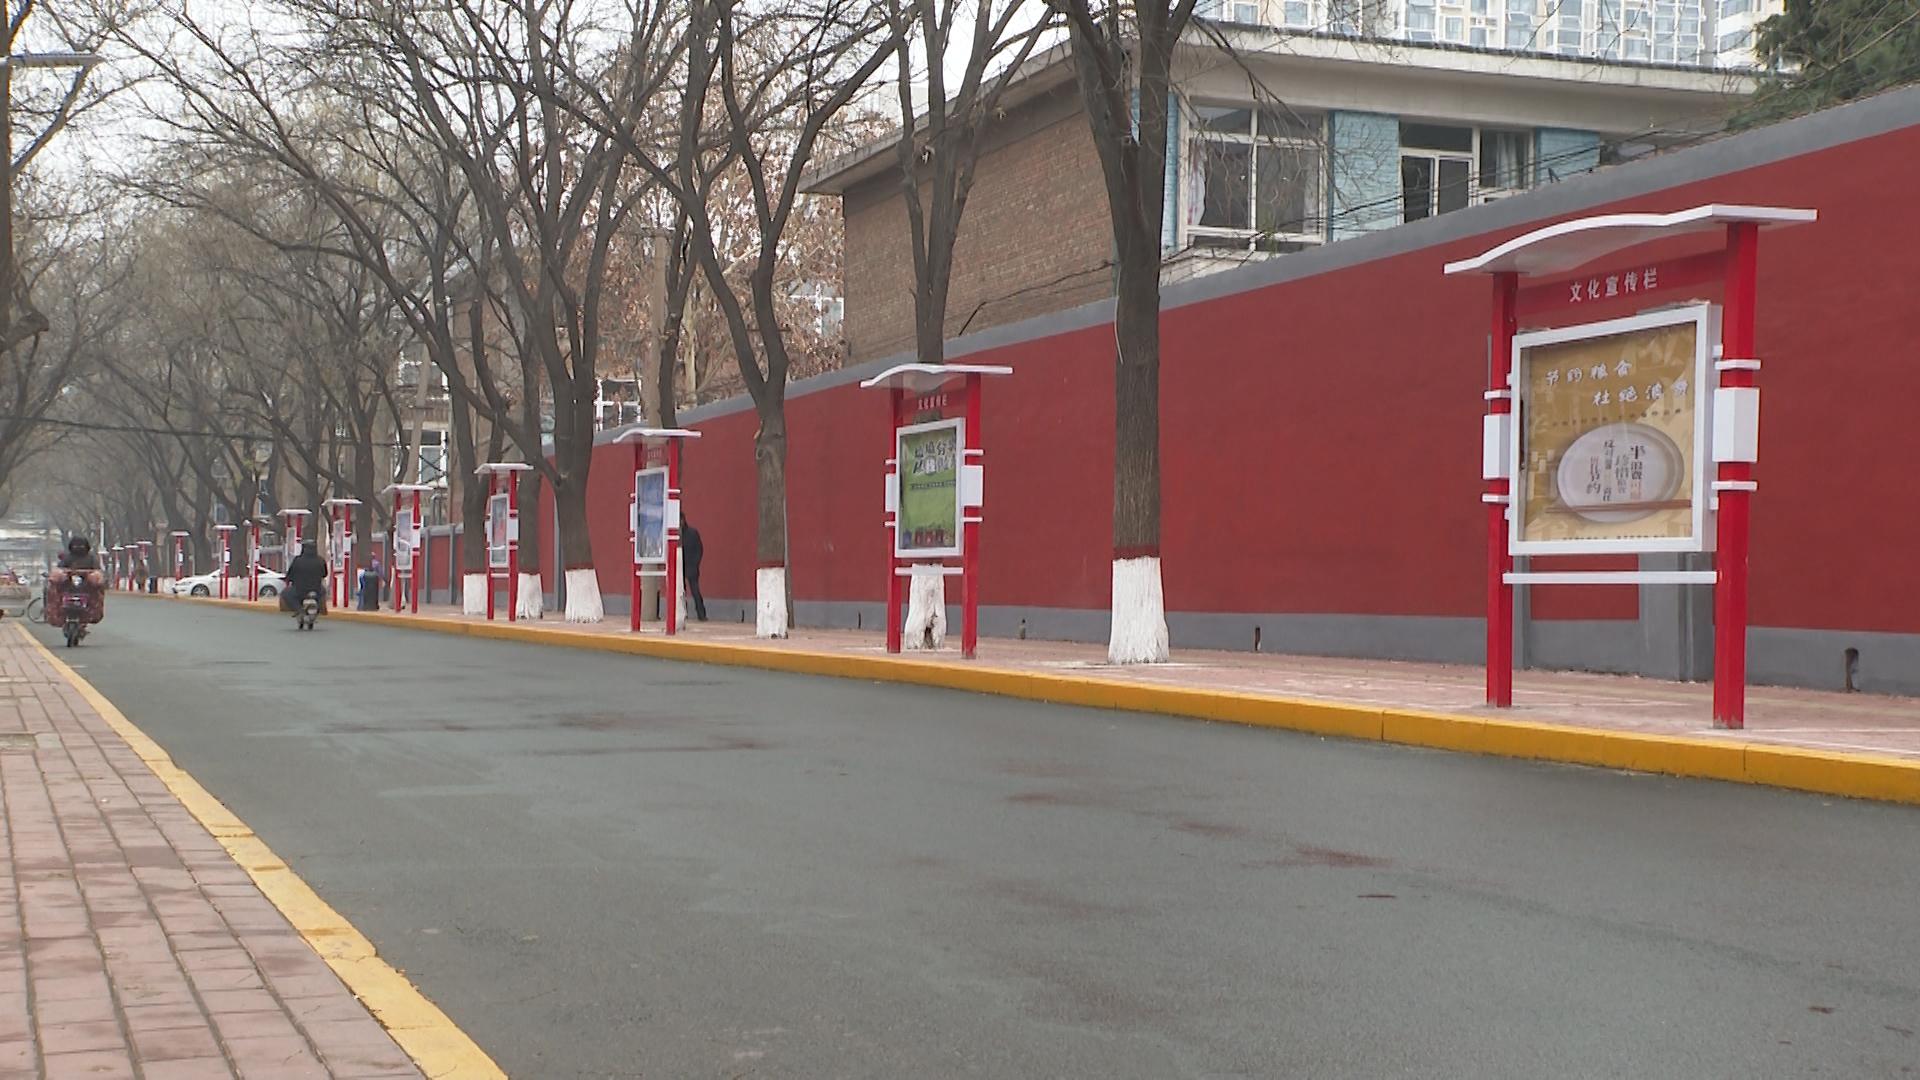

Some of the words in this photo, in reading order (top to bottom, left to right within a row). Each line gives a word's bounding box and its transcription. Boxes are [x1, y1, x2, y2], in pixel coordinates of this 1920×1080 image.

[1569, 267, 1658, 303] 文化宣传栏
[1545, 360, 1632, 386] 节约粮食
